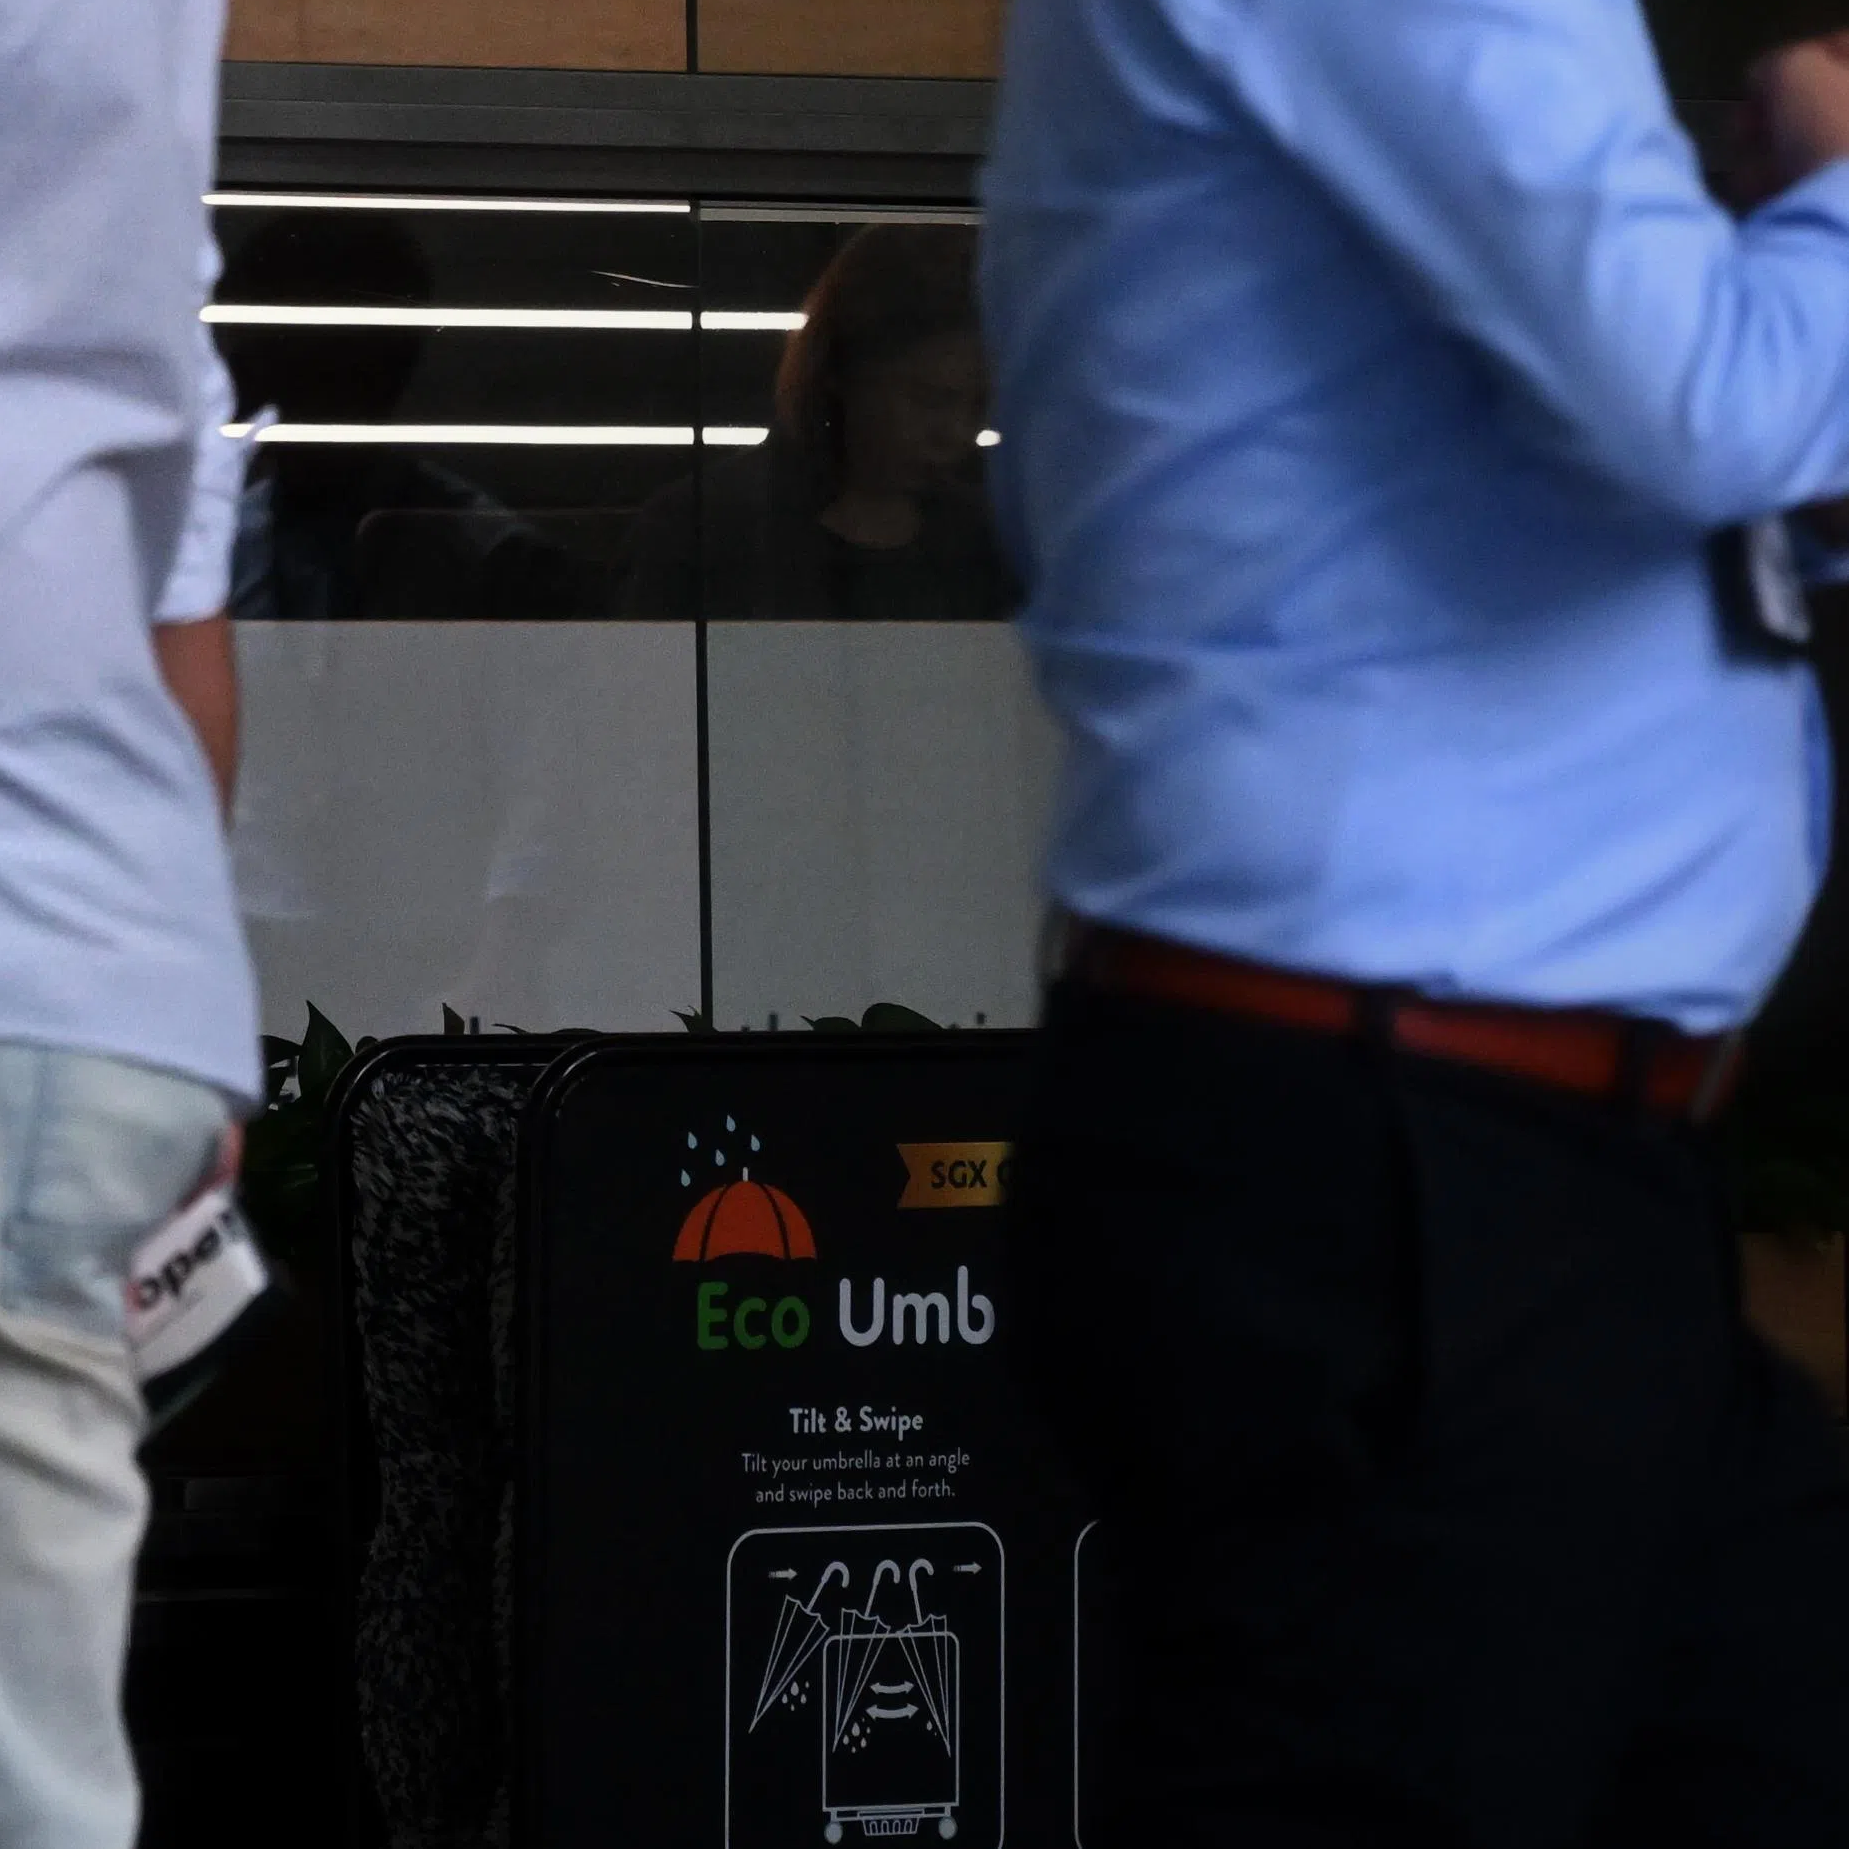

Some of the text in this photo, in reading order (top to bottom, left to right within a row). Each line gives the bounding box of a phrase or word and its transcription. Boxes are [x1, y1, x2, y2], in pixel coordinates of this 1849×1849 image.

[930, 1158, 988, 1190] SGX
[695, 1264, 996, 1351] Eco Umb
[788, 1405, 925, 1442] Tilt & Swipe
[740, 1446, 971, 1479] Tilt your umbrella at an angle
[755, 1477, 957, 1509] and swipe back and forth.
